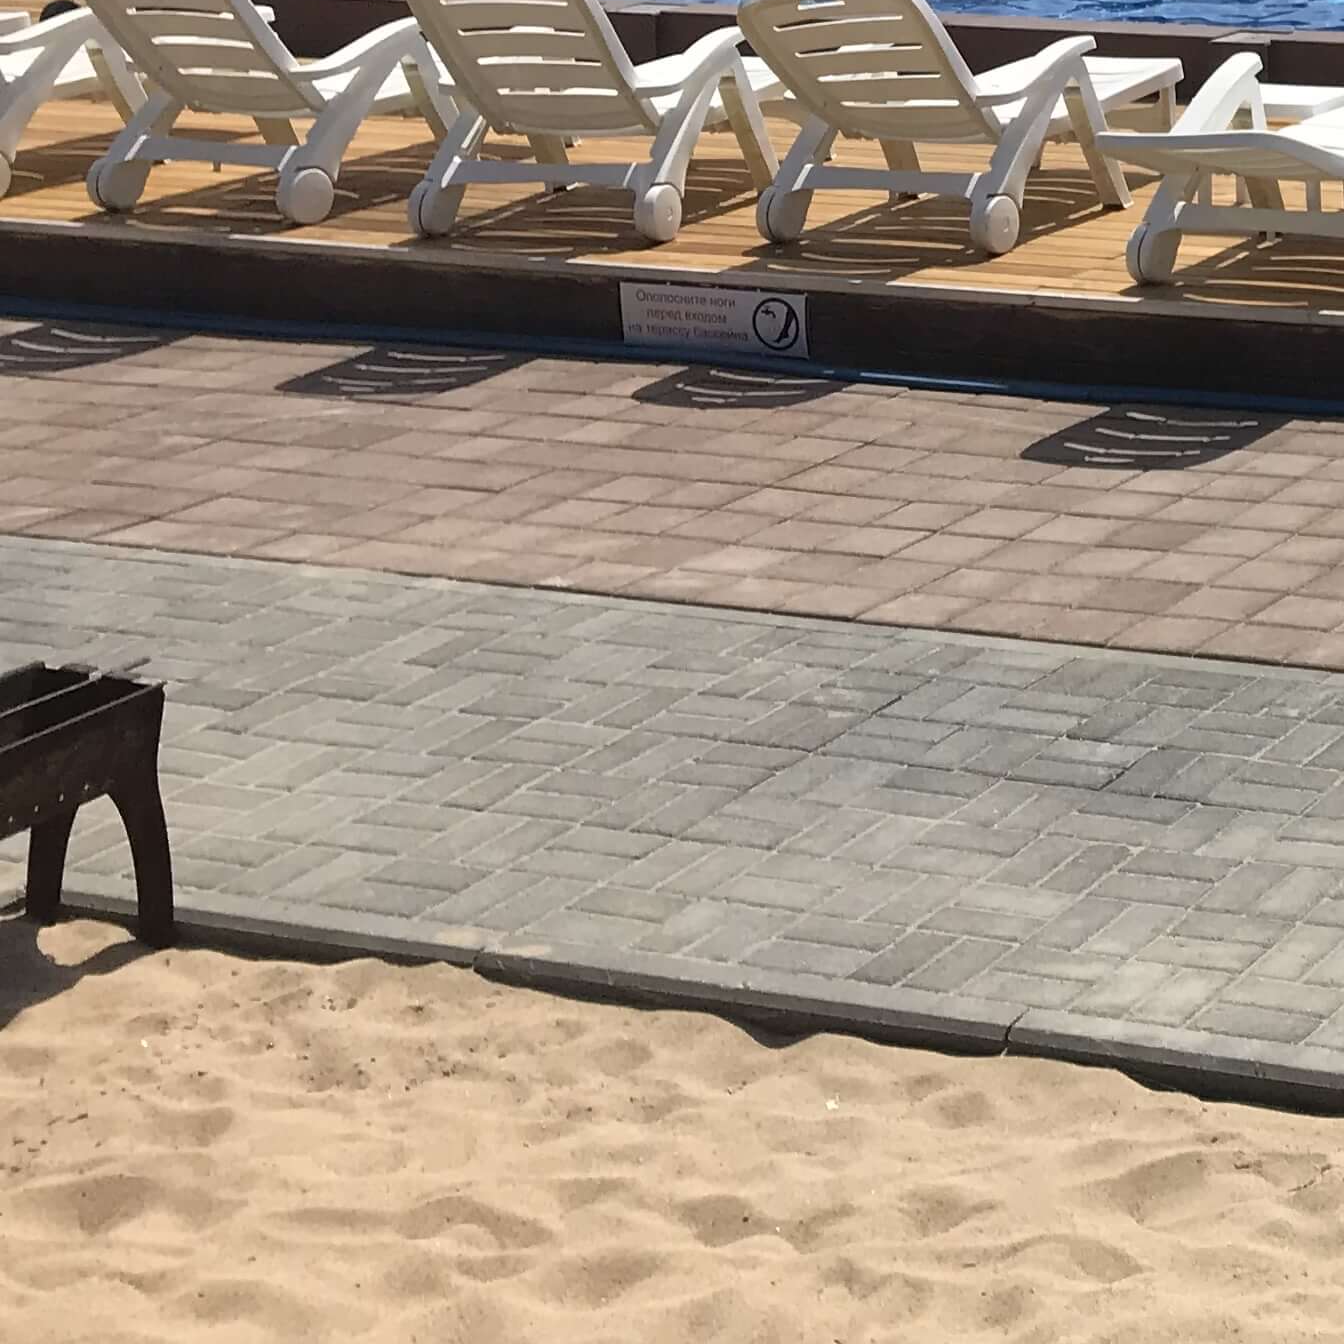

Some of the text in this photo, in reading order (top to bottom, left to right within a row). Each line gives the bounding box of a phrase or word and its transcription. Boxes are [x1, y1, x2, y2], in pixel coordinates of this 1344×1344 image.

[635, 289, 736, 309] Ополосните ноги
[646, 309, 727, 324] перед входом
